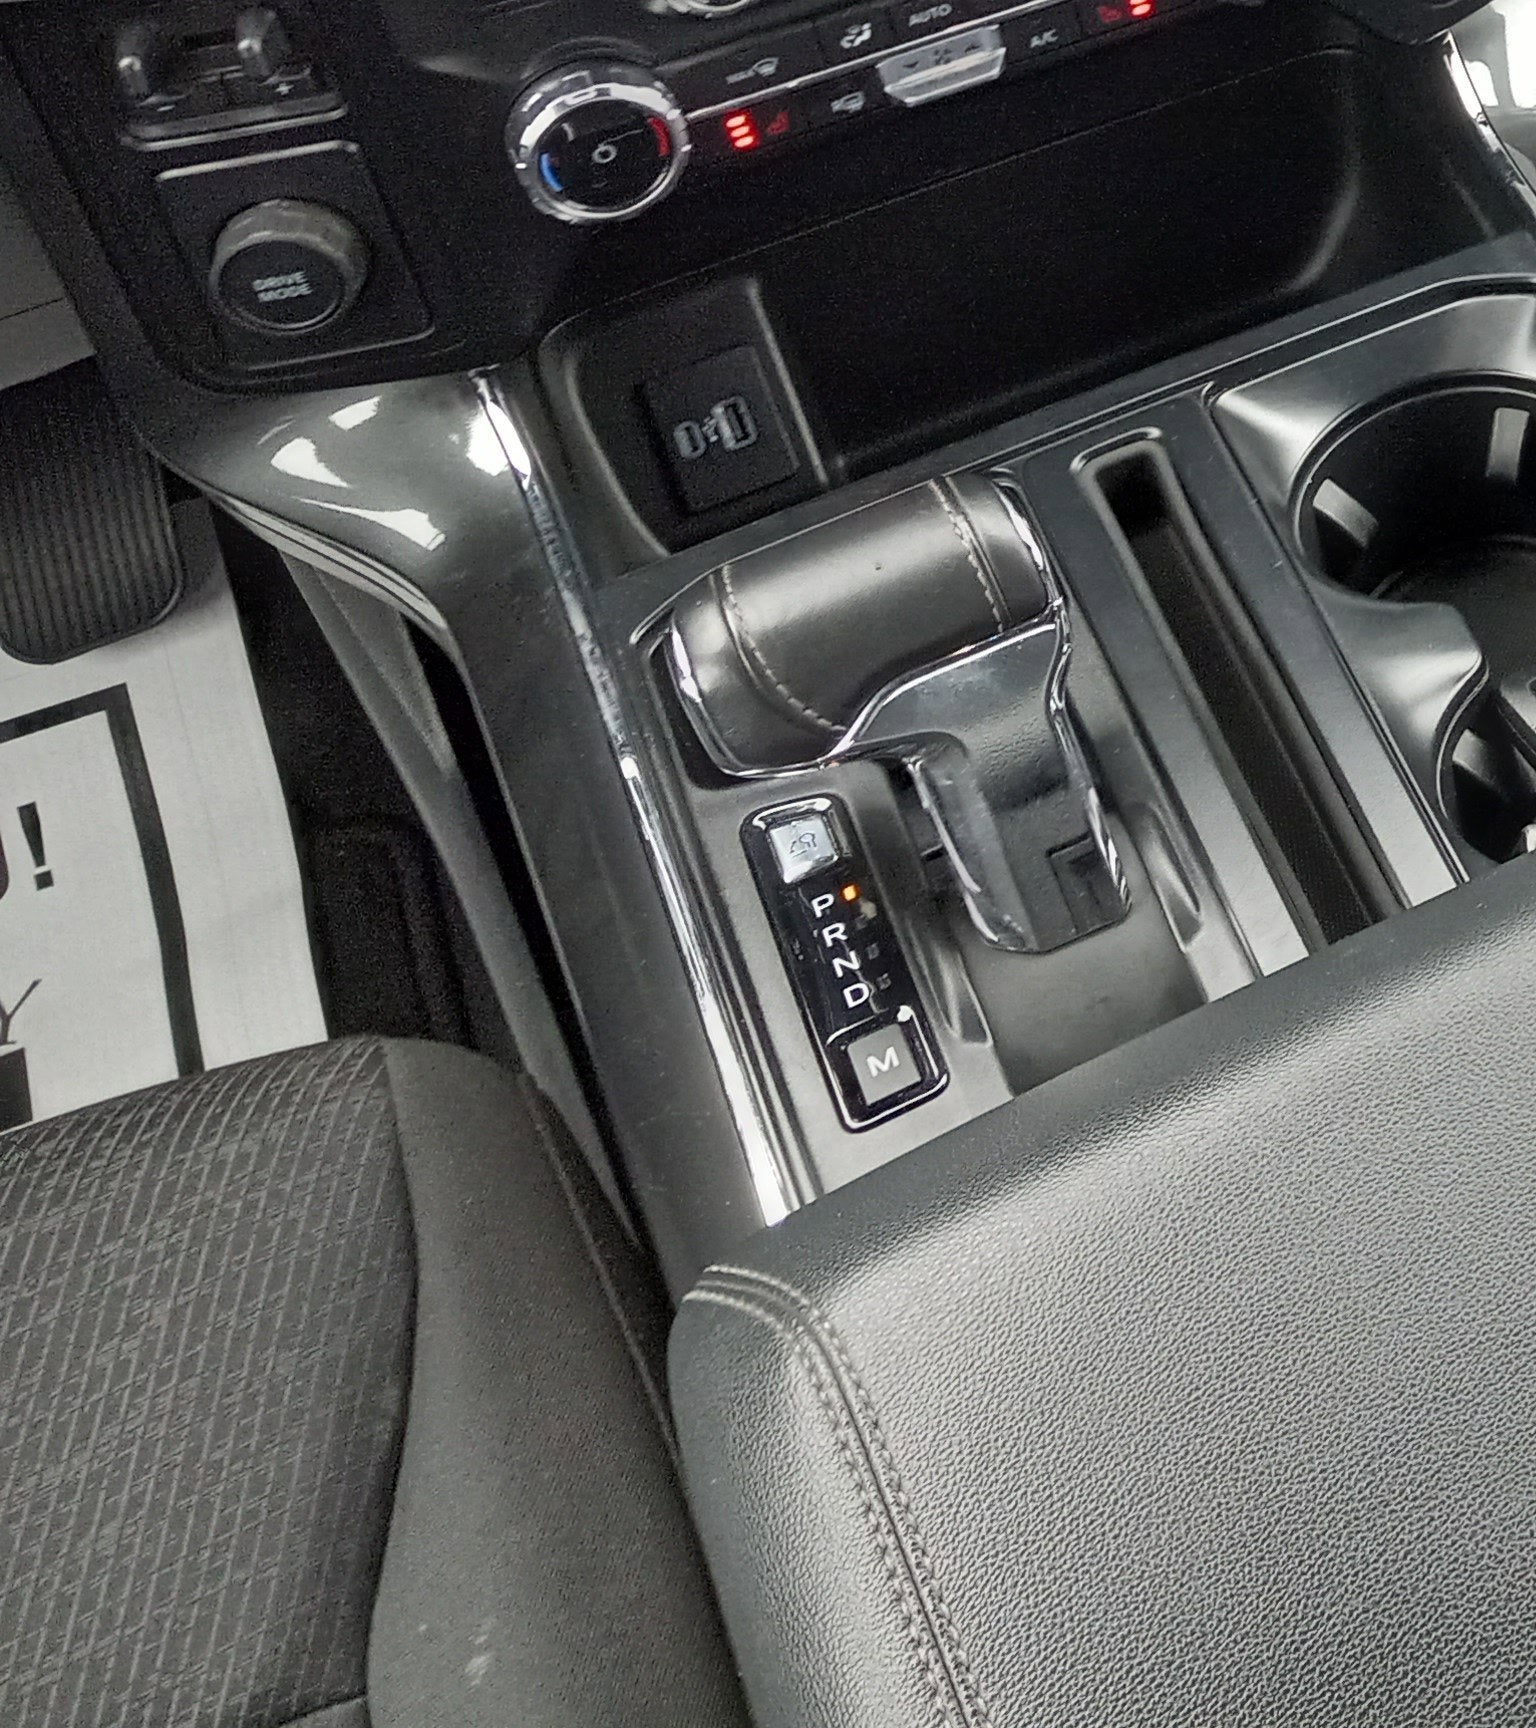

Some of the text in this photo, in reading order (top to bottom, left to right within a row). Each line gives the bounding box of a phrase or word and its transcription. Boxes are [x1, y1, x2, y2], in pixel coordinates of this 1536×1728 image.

[907, 2, 953, 28] AUTO
[1029, 27, 1060, 50] A/C
[252, 270, 309, 292] DRIVE
[257, 282, 314, 303] MODE
[811, 891, 836, 919] P
[821, 921, 847, 948] R
[832, 952, 861, 979] N
[842, 982, 871, 1010] D
[865, 1046, 900, 1077] M
